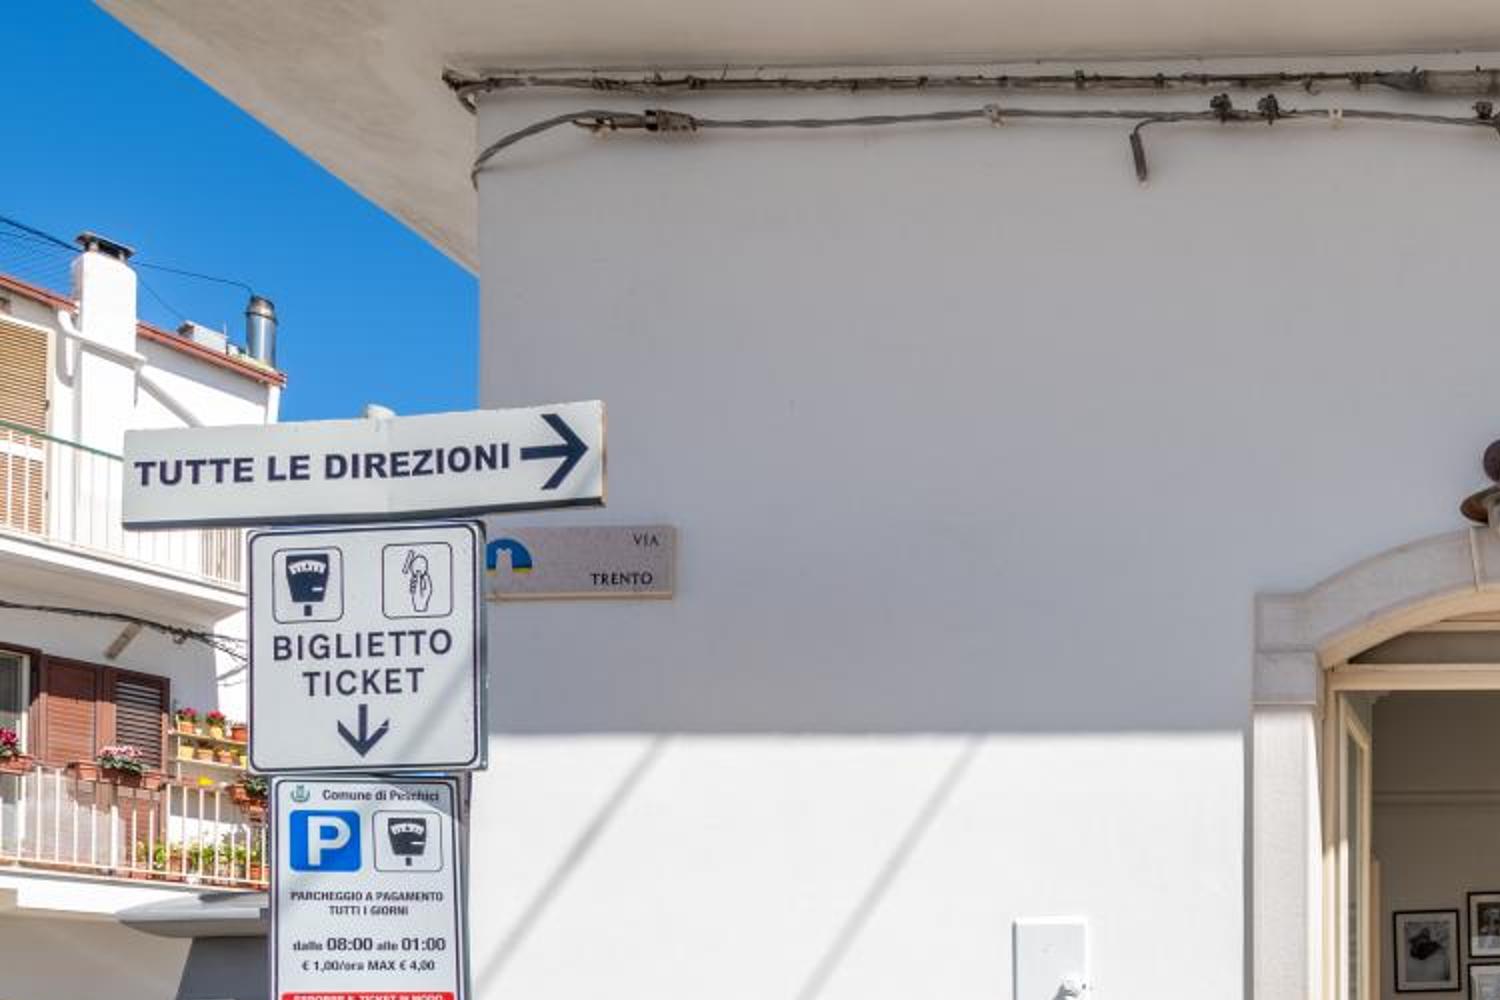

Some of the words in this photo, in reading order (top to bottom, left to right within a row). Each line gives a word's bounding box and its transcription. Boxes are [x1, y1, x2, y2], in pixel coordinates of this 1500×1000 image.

[135, 457, 254, 487] TUTTE
[267, 454, 310, 481] LE
[325, 443, 510, 480] DIREZIONI
[633, 533, 660, 548] VIA
[590, 571, 654, 587] TRENTO
[273, 629, 453, 661] BIGLIETTO
[302, 667, 425, 697] TICKET
[322, 789, 372, 801] Comune
[375, 789, 387, 801] di
[307, 816, 351, 866] P
[290, 891, 362, 901] PARCHEGGIO
[365, 891, 373, 901] A
[376, 891, 443, 901] PAGAMENTO
[328, 905, 361, 915] TUTTI
[370, 905, 409, 915] GIORNI
[293, 940, 323, 951] dalle
[326, 937, 373, 951] 08:00
[376, 940, 399, 951] alle
[401, 937, 446, 951] 01:00
[302, 961, 309, 970] €
[367, 960, 395, 971] MAX
